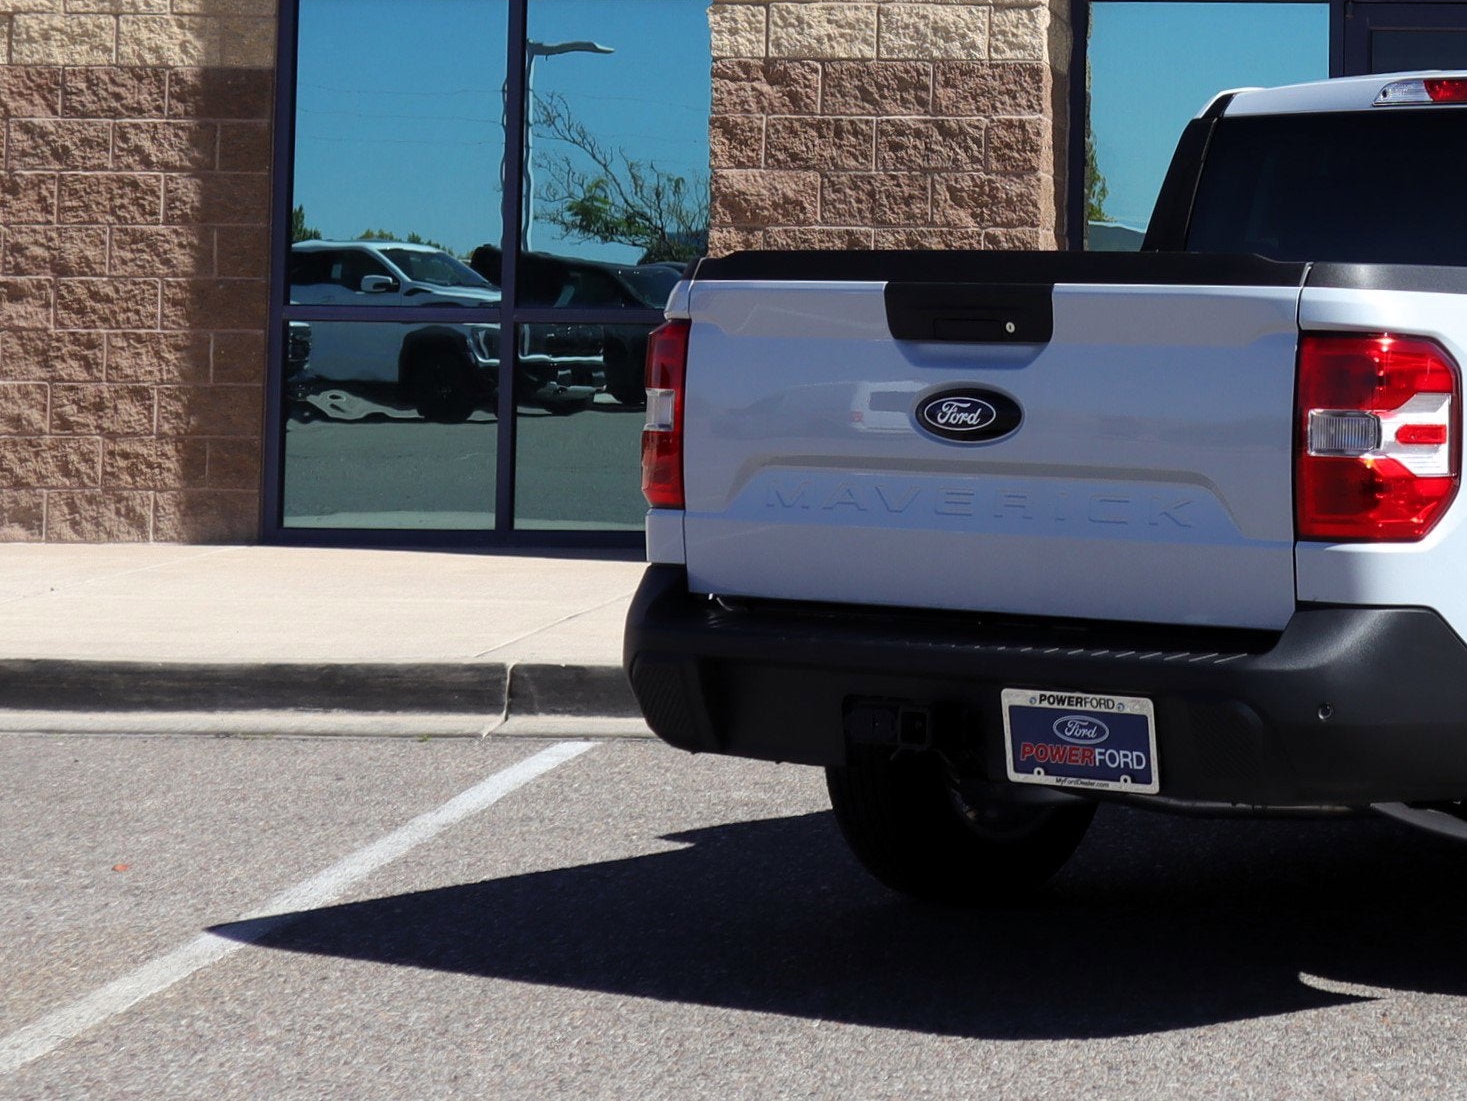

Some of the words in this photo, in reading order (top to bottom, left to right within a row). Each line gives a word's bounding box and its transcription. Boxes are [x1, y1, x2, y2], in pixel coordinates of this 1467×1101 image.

[937, 401, 982, 425] Ford
[767, 481, 1194, 528] MAVERICK
[1039, 694, 1115, 710] POWERFORD
[1064, 720, 1097, 739] Ford
[1020, 742, 1146, 769] POWERFORD
